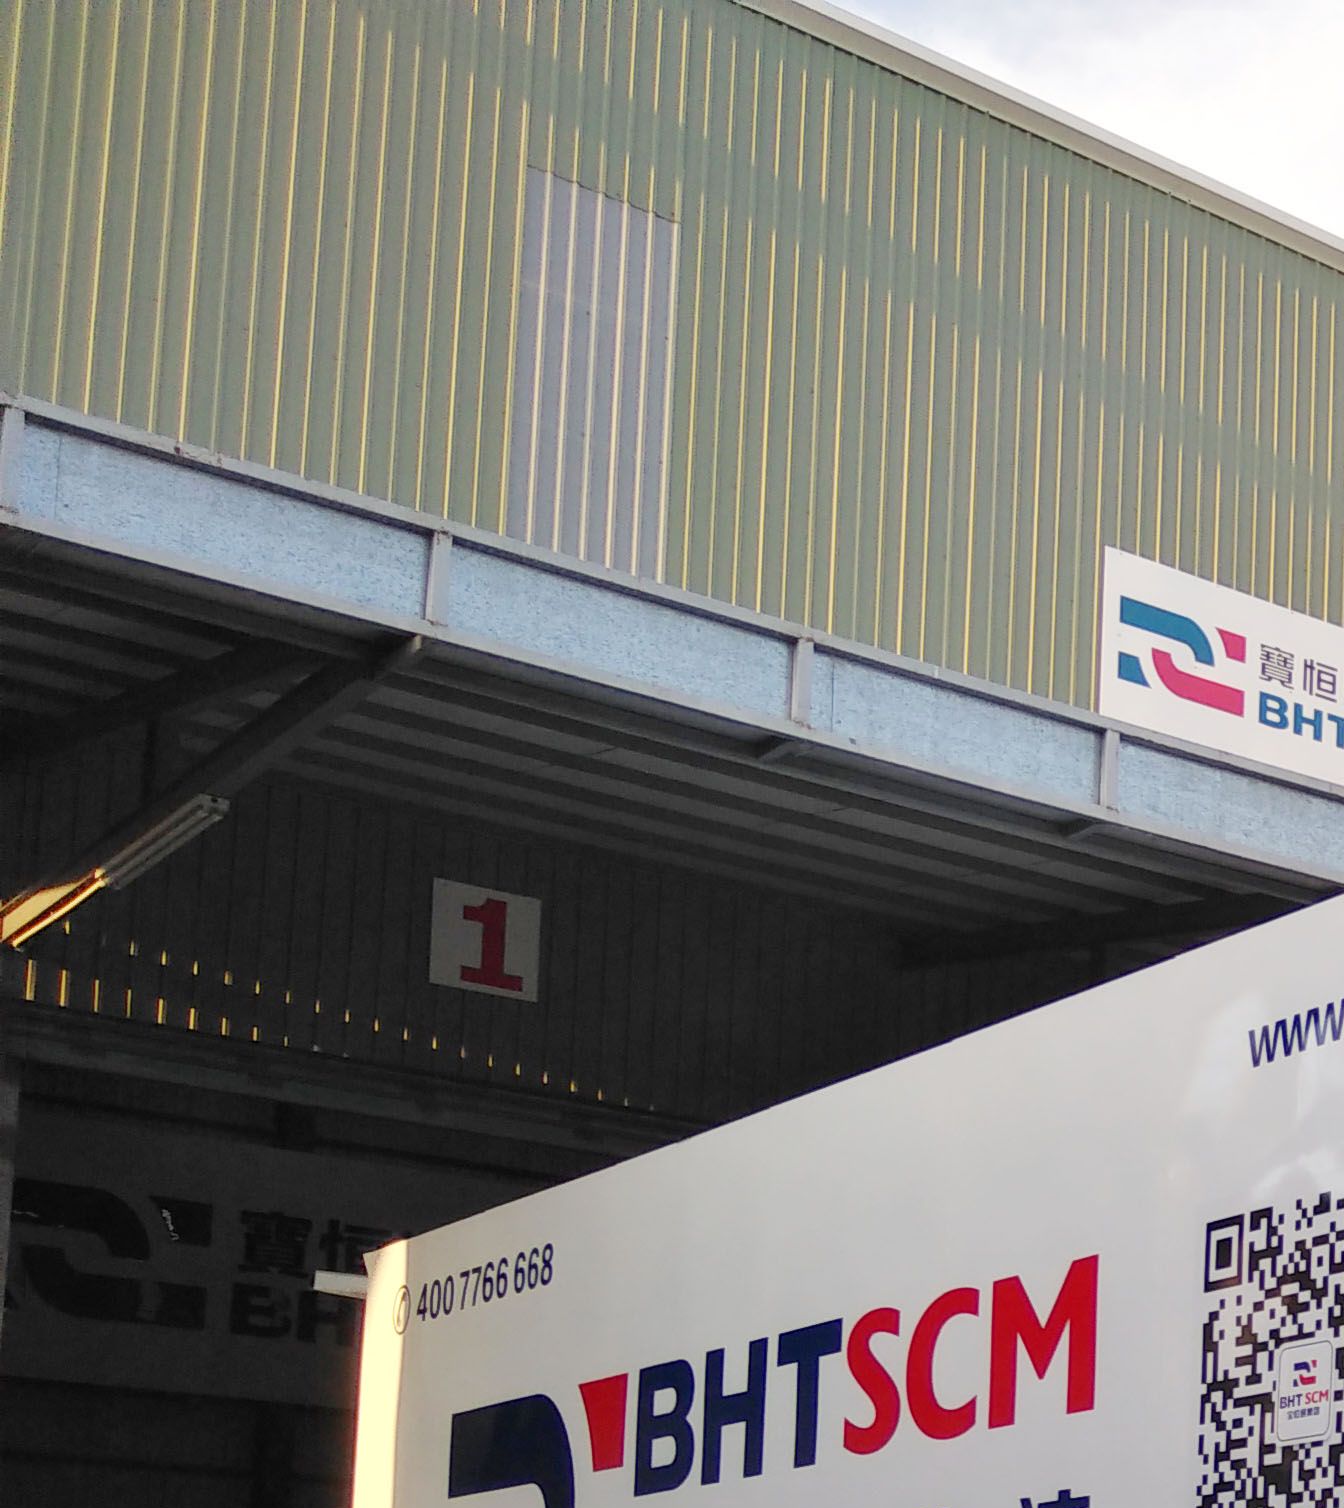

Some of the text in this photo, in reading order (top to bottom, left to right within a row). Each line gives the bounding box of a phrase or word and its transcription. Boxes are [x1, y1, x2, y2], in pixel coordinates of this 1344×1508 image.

[460, 898, 524, 992] 1
[416, 1242, 555, 1322] 400 7766 668
[1280, 1389, 1329, 1409] BHT SCM
